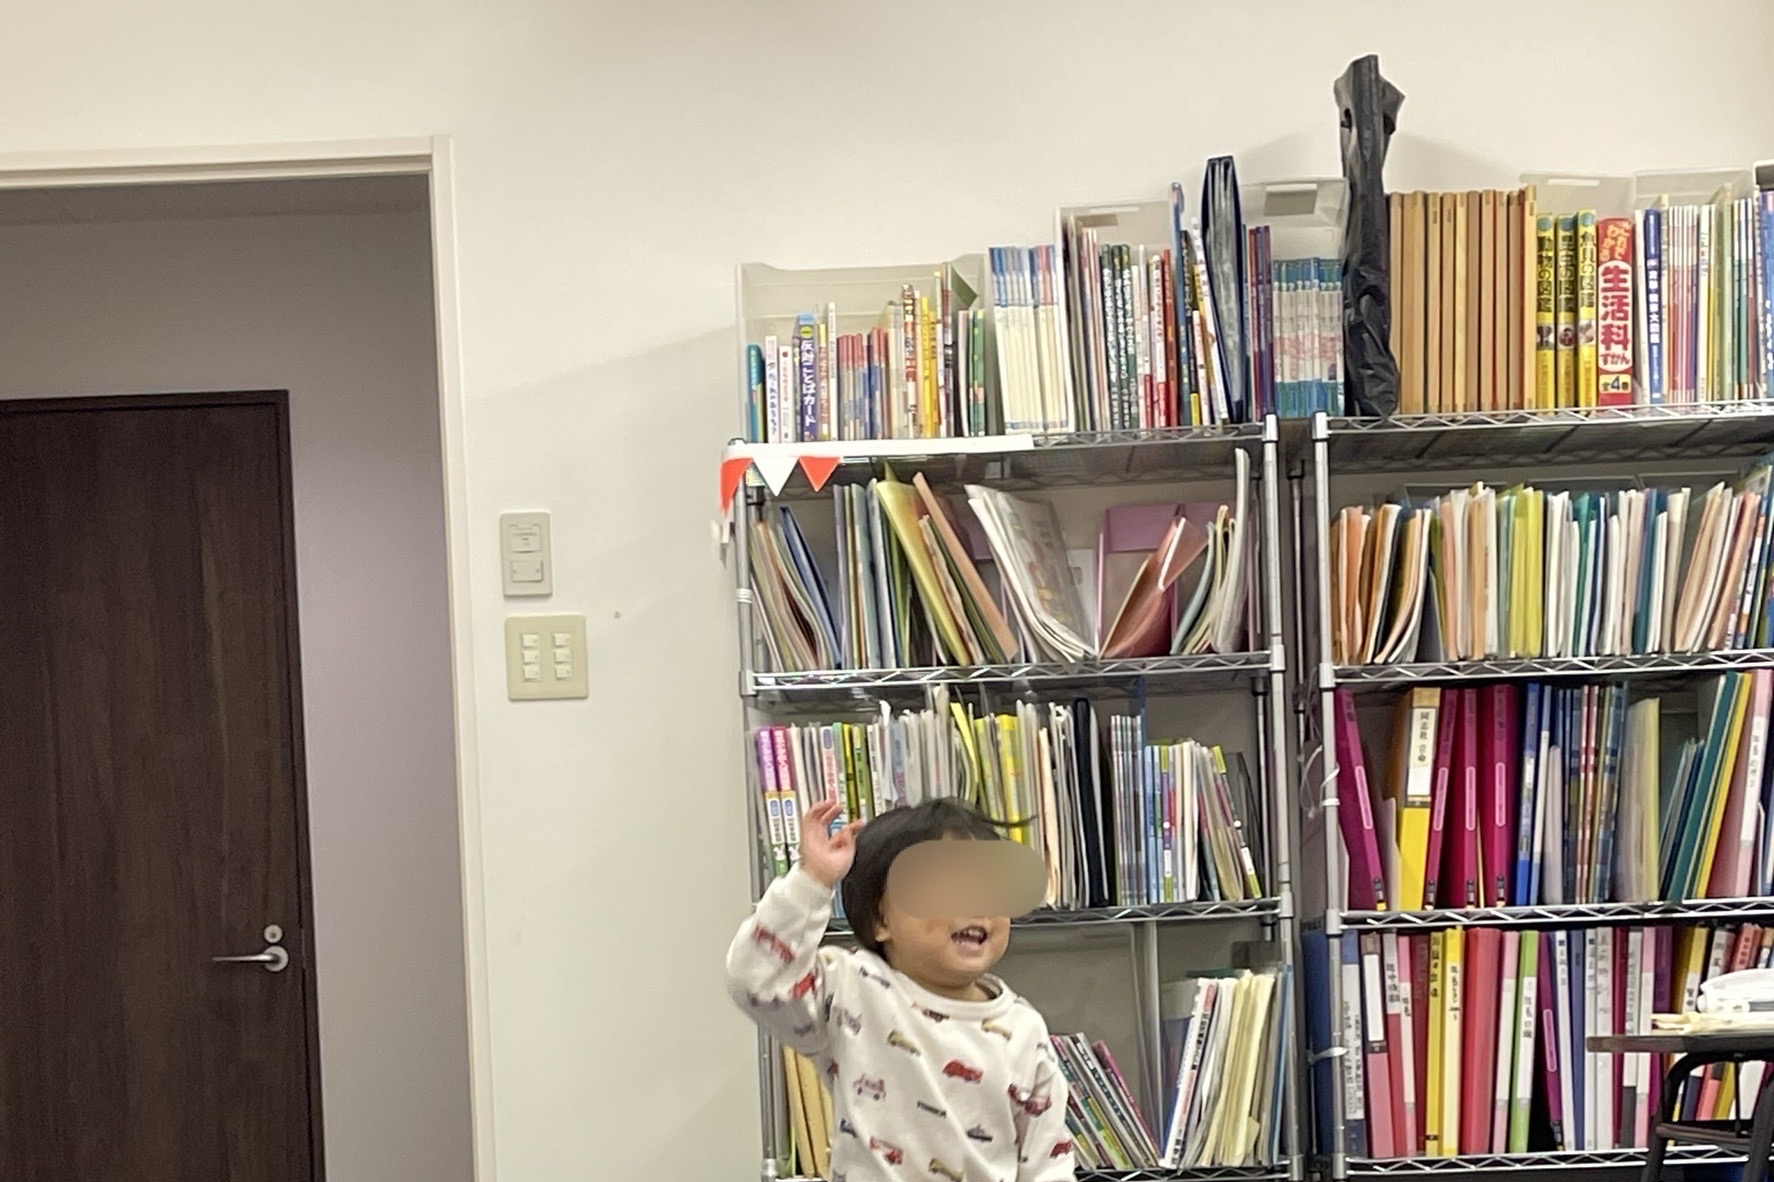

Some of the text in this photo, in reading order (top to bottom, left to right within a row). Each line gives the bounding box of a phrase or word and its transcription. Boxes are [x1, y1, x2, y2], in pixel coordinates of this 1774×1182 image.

[1601, 265, 1630, 350] 生活科
[1601, 353, 1630, 366] ずかん
